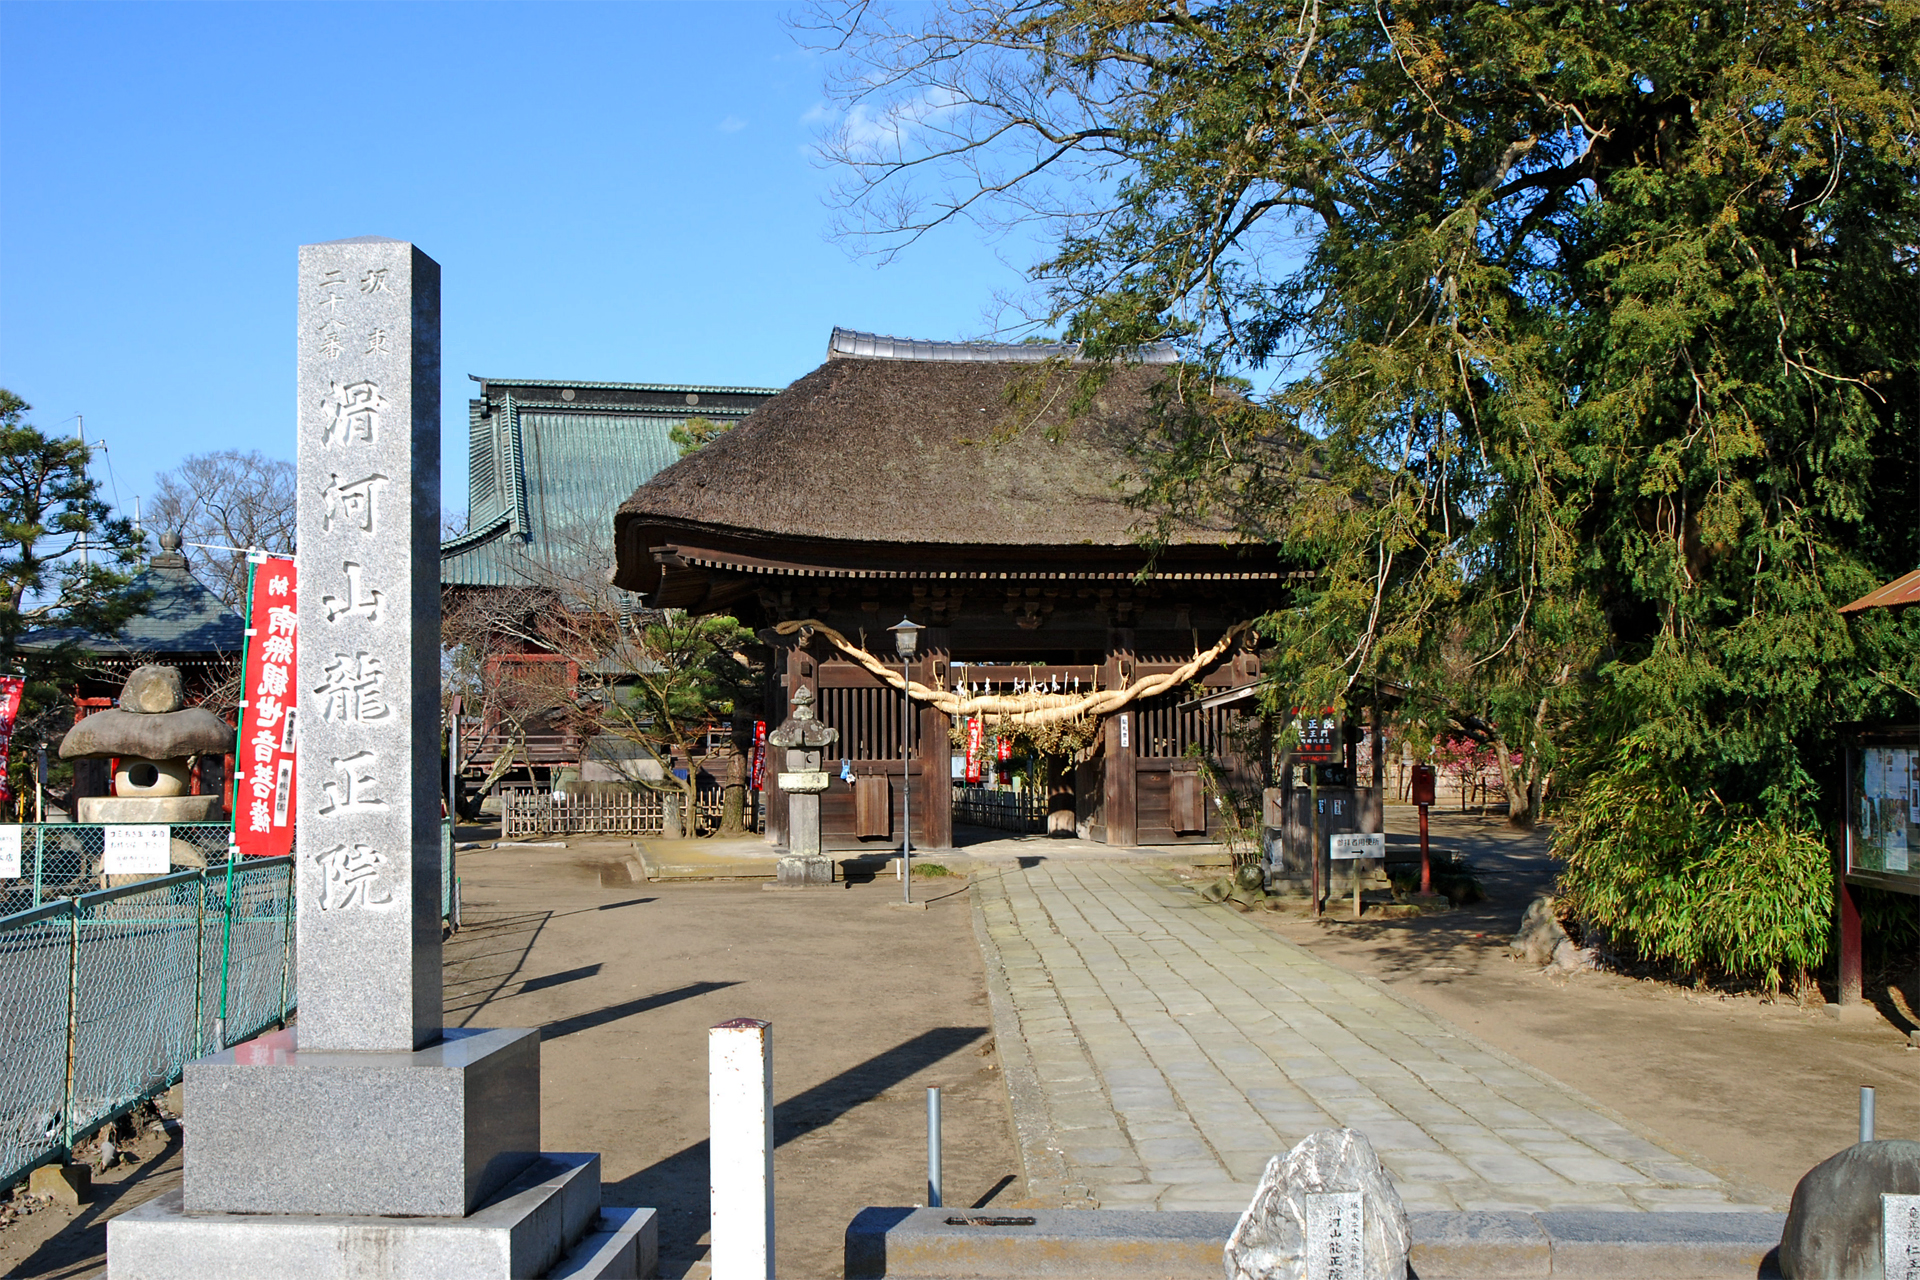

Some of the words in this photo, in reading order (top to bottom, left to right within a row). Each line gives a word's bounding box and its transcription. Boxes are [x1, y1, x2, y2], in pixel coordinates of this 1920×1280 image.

[318, 270, 348, 360] 二十八番
[360, 268, 394, 356] 坂東
[314, 378, 393, 912] 滑河山龍正院
